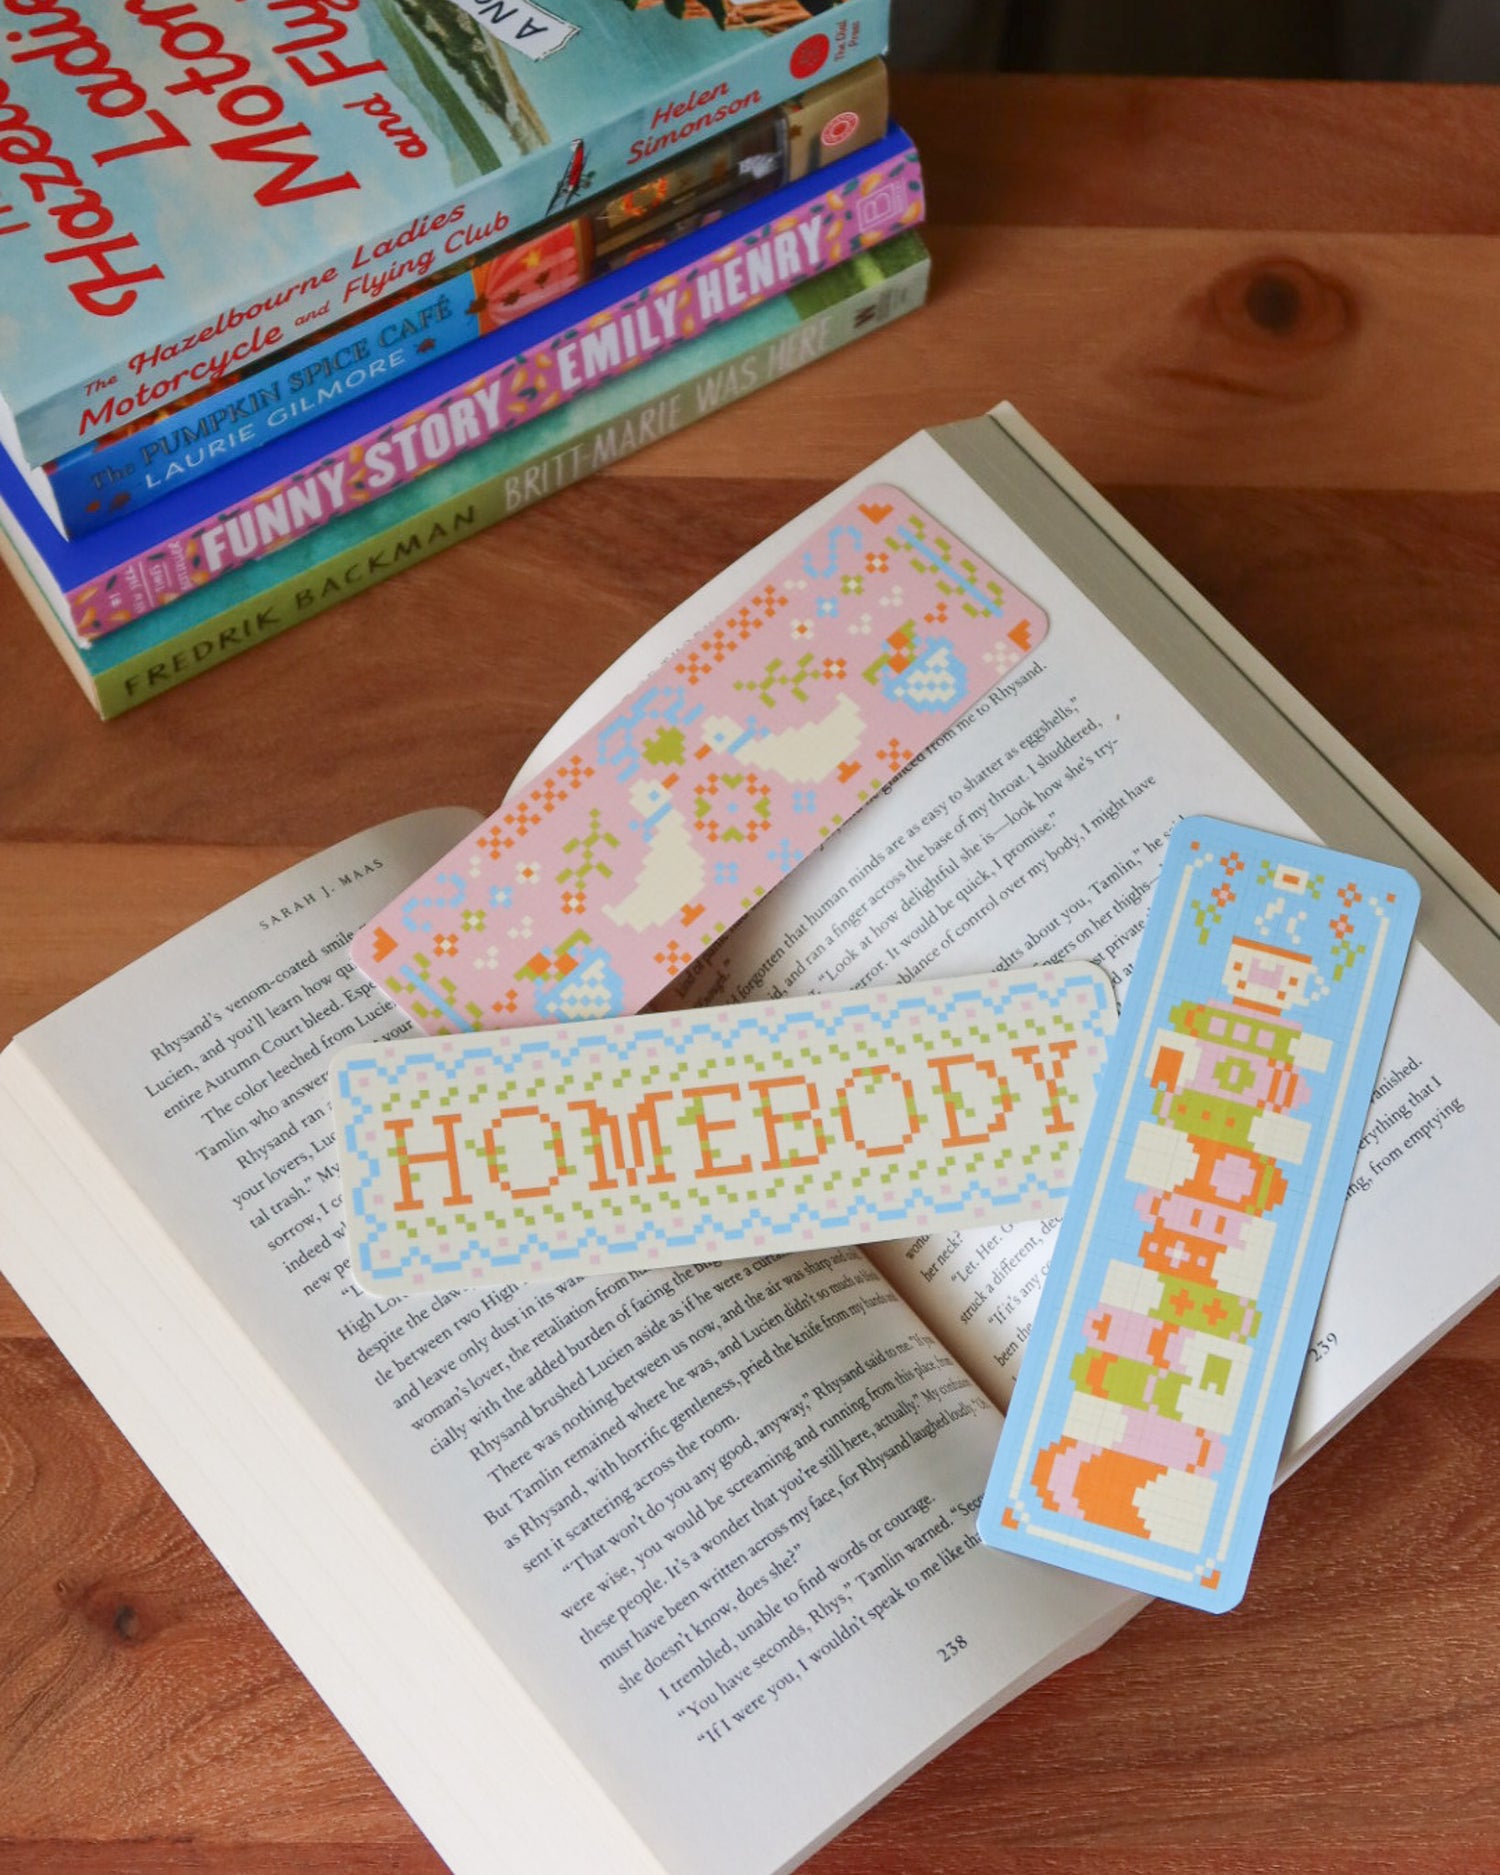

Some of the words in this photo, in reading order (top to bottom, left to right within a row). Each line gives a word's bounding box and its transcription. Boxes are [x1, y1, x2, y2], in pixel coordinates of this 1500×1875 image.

[515, 17, 548, 39] A
[342, 92, 428, 159] and
[626, 88, 761, 165] Simonson
[651, 80, 729, 130] Helen
[79, 325, 284, 436] Motorcycle
[294, 303, 331, 328] and
[343, 249, 435, 304] Flying
[444, 213, 510, 253] Club
[85, 375, 118, 396] The
[128, 265, 338, 373] Hazelbourne
[352, 203, 466, 271] Ladies
[556, 291, 682, 392] EMILY
[696, 215, 827, 321] HENRY
[91, 461, 136, 491] The
[140, 384, 283, 466] PUMPKIN
[288, 344, 371, 393] SPICE
[378, 293, 454, 348] CAFÉ
[145, 425, 257, 489] LAURIE
[267, 351, 407, 428] GILMORE
[505, 395, 682, 511] BRITT-MARIE
[696, 356, 758, 412] WAS
[767, 315, 832, 377] HERE
[200, 461, 350, 574] FUNNY
[363, 380, 506, 488] STORY
[123, 606, 283, 697] FREDRIK
[294, 506, 478, 610] BACKMAN
[259, 893, 317, 931] SARAH
[319, 885, 336, 899] J.
[337, 858, 384, 886] MAAS
[737, 947, 786, 998] forgotten
[783, 923, 809, 949] that
[802, 886, 849, 927] human
[847, 852, 886, 888] minds
[885, 835, 906, 856] are
[905, 824, 921, 838] as
[921, 801, 949, 826] easy
[948, 790, 963, 804] to
[963, 757, 1005, 793] shatter
[1004, 747, 1020, 761] as
[1019, 697, 1080, 750] eggshells,”
[784, 959, 807, 987] and
[805, 944, 827, 965] ran
[824, 935, 835, 946] a
[831, 902, 869, 938] finger
[867, 870, 907, 906] across
[904, 853, 927, 873] the
[922, 831, 954, 857] base
[953, 814, 968, 834] of
[967, 803, 989, 823] my
[987, 772, 1030, 806] throat.
[1026, 763, 1038, 776] I
[1036, 717, 1103, 769] shuddered,
[940, 929, 956, 950] of
[948, 894, 1000, 937] control
[999, 875, 1027, 900] over
[1026, 858, 1049, 878] my
[1044, 833, 1086, 862] body,
[1080, 822, 1092, 835] I
[1090, 797, 1128, 829] might
[1122, 776, 1156, 801] have
[1024, 918, 1062, 951] about
[1060, 898, 1093, 925] you,
[1087, 847, 1143, 895] Tamlin,”
[150, 1012, 223, 1061] Rhysand's
[224, 949, 319, 1013] venom-coated
[320, 931, 354, 956] smile
[1105, 920, 1146, 959] private
[143, 1064, 200, 1098] Lucien,
[199, 1038, 227, 1063] and
[226, 1012, 267, 1049] you'll
[264, 994, 304, 1019] learn
[300, 974, 332, 997] how
[164, 1089, 204, 1119] entire
[205, 1052, 262, 1094] Autumn
[261, 1024, 304, 1054] Court
[299, 998, 344, 1029] bleed.
[200, 1102, 233, 1124] The
[234, 1078, 269, 1106] color
[266, 1042, 322, 1083] leeched
[320, 1024, 356, 1049] from
[1408, 1084, 1435, 1107] that
[1430, 1073, 1443, 1088] I
[232, 1180, 266, 1211] your
[262, 1152, 314, 1185] lovers,
[384, 1039, 1080, 1212] HOMEBODY
[1369, 1147, 1404, 1176] from
[1403, 1097, 1466, 1149] emptying
[249, 1208, 271, 1229] tal
[270, 1176, 312, 1215] trash.”
[960, 1290, 988, 1325] struck
[985, 1283, 995, 1294] a
[991, 1236, 1044, 1285] different,
[374, 1369, 394, 1386] tle
[391, 1328, 454, 1373] between
[453, 1308, 482, 1331] two
[392, 1382, 421, 1410] and
[417, 1360, 458, 1390] leave
[458, 1337, 490, 1363] only
[490, 1315, 521, 1340] dust
[518, 1305, 537, 1320] in
[534, 1292, 555, 1308] its
[430, 1423, 468, 1455] cially
[468, 1399, 503, 1425] with
[501, 1383, 526, 1404] the
[526, 1349, 568, 1387] added
[564, 1320, 617, 1358] burden
[616, 1303, 632, 1323] of
[630, 1281, 676, 1313] facing
[672, 1265, 695, 1286] the
[1311, 1332, 1339, 1362] 239
[523, 1547, 554, 1573] sent
[549, 1538, 566, 1551] it
[565, 1487, 636, 1542] scattering
[633, 1457, 676, 1492] across
[675, 1440, 699, 1461] the
[699, 1414, 740, 1444] room.
[618, 1671, 643, 1694] she
[643, 1632, 694, 1675] doesn't
[689, 1602, 738, 1637] know,
[736, 1575, 769, 1603] does
[768, 1543, 801, 1580] she?”
[657, 1686, 671, 1702] I
[670, 1637, 739, 1693] trembled,
[736, 1603, 783, 1642] unable
[782, 1592, 799, 1607] to
[797, 1565, 828, 1595] find
[827, 1540, 868, 1572] words
[867, 1528, 883, 1543] or
[884, 1495, 936, 1532] courage.
[696, 1722, 723, 1743] “If
[719, 1718, 732, 1732] I
[731, 1694, 767, 1723] were
[766, 1672, 802, 1702] you,
[796, 1658, 809, 1673] I
[808, 1615, 868, 1663] wouldn't
[867, 1587, 906, 1621] speak
[904, 1577, 921, 1592] to
[919, 1562, 942, 1581] me
[936, 1545, 965, 1566] like
[936, 1634, 968, 1664] 238
